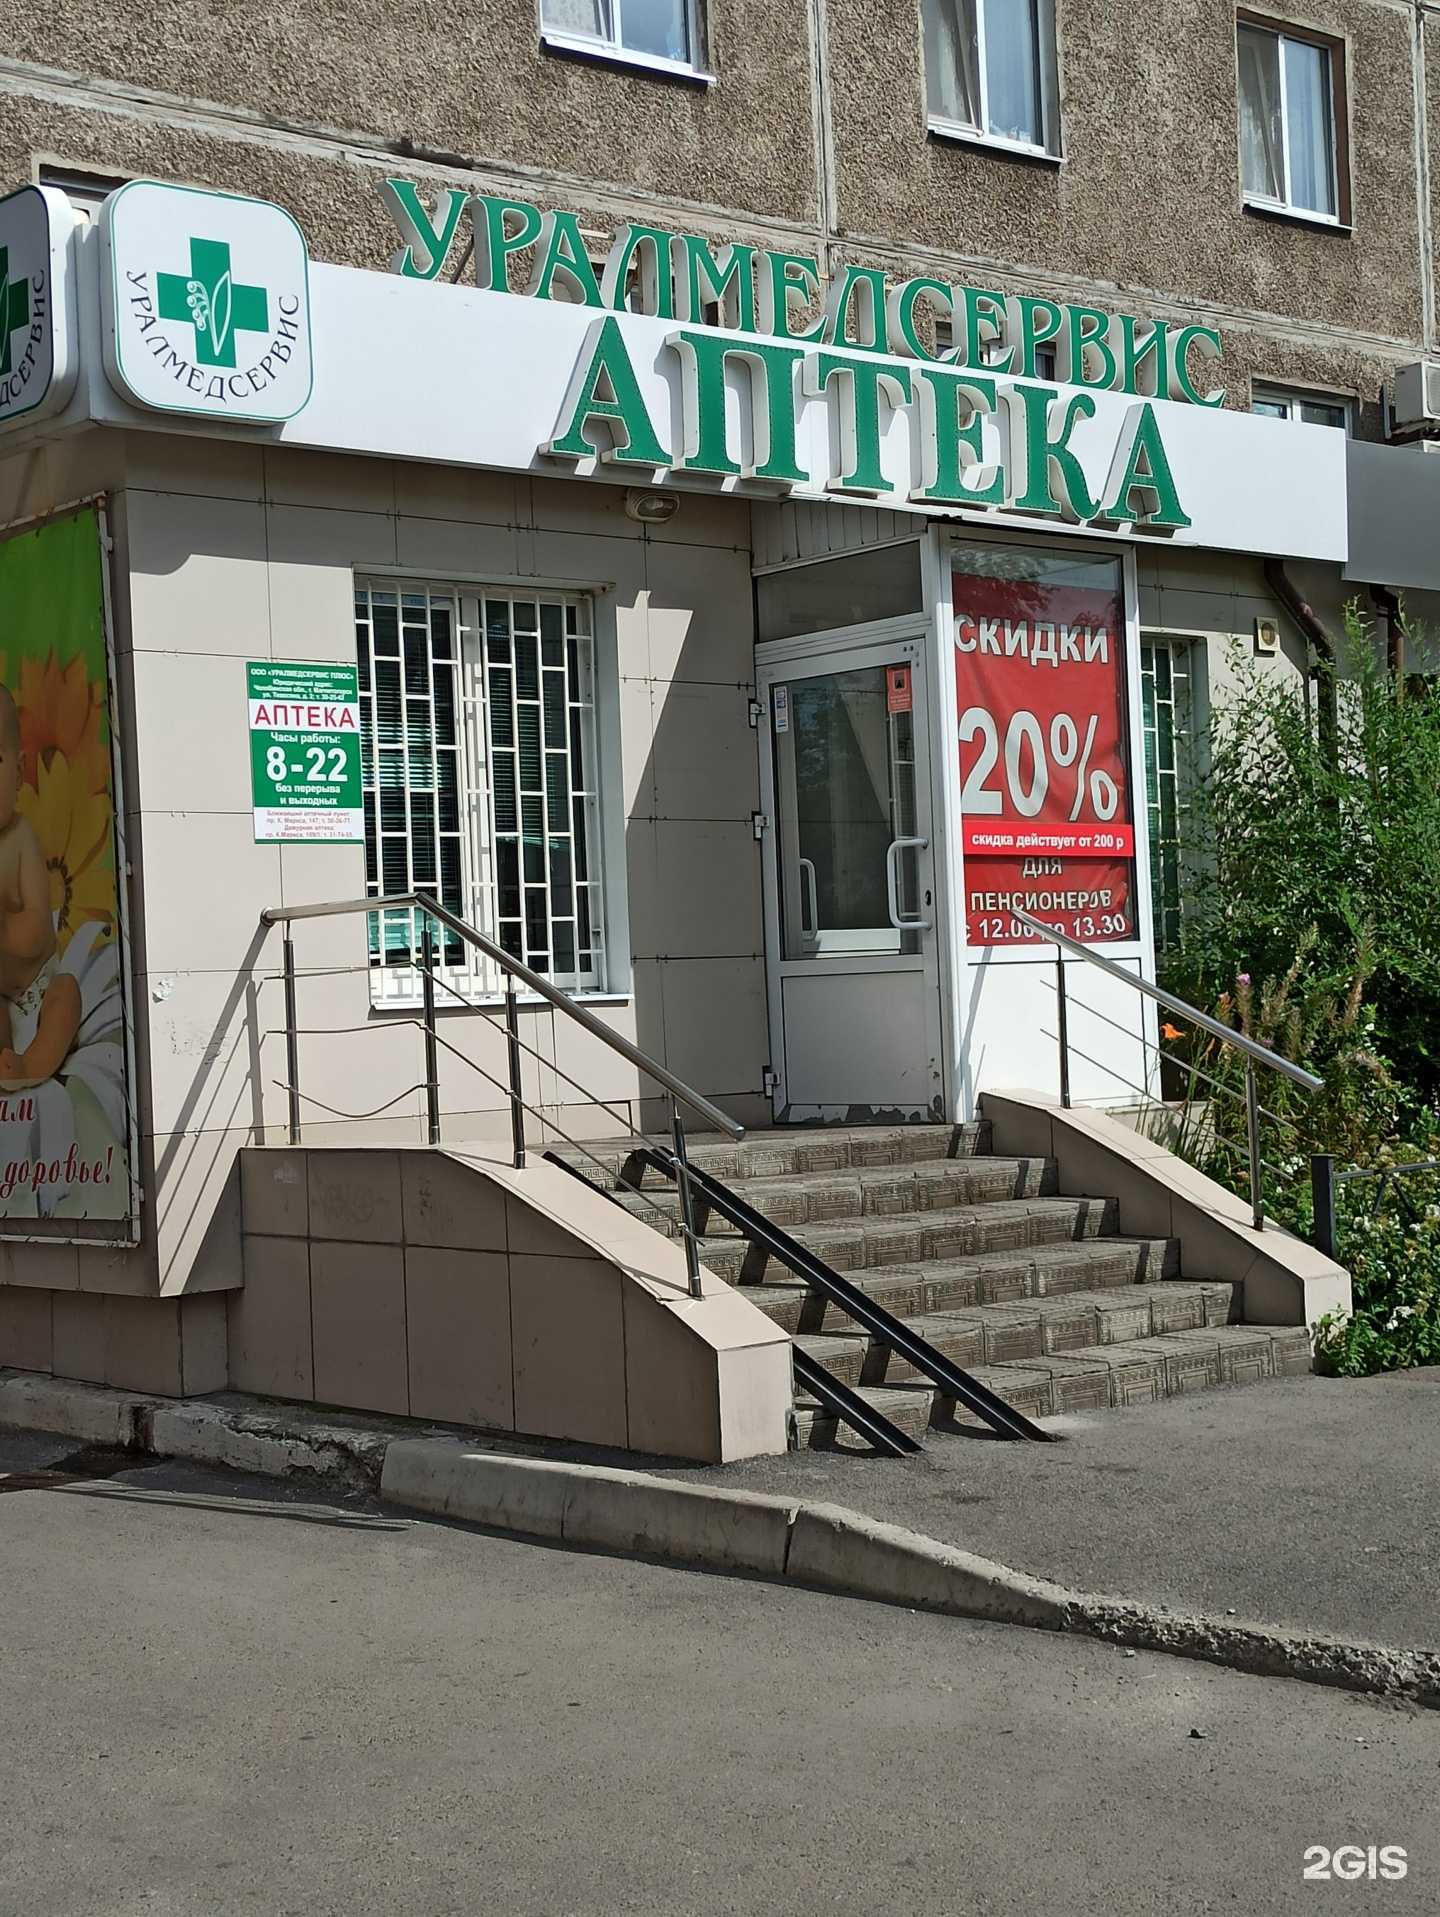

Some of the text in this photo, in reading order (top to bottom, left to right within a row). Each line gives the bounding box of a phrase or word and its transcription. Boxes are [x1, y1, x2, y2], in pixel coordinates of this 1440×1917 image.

[384, 177, 1226, 408] УРАЛМЕДСЕРВИС
[126, 269, 300, 404] УРАЛМЕДСЕРВИС
[548, 316, 1192, 529] АПТЕКА
[953, 614, 1109, 668] СКИДКИ
[255, 704, 355, 729] АПТЕКА
[270, 731, 341, 745] Часы работы:
[266, 746, 348, 782] 8-22
[958, 706, 1119, 822] 20%
[275, 783, 341, 795] без перерыва
[279, 796, 338, 806] и выходных
[972, 833, 1124, 850] скидка действует от 200 р
[1022, 857, 1063, 879] ДЛЯ
[970, 889, 1112, 912] ПЕНСИОНЕРОВ
[1073, 913, 1126, 937] 13.30
